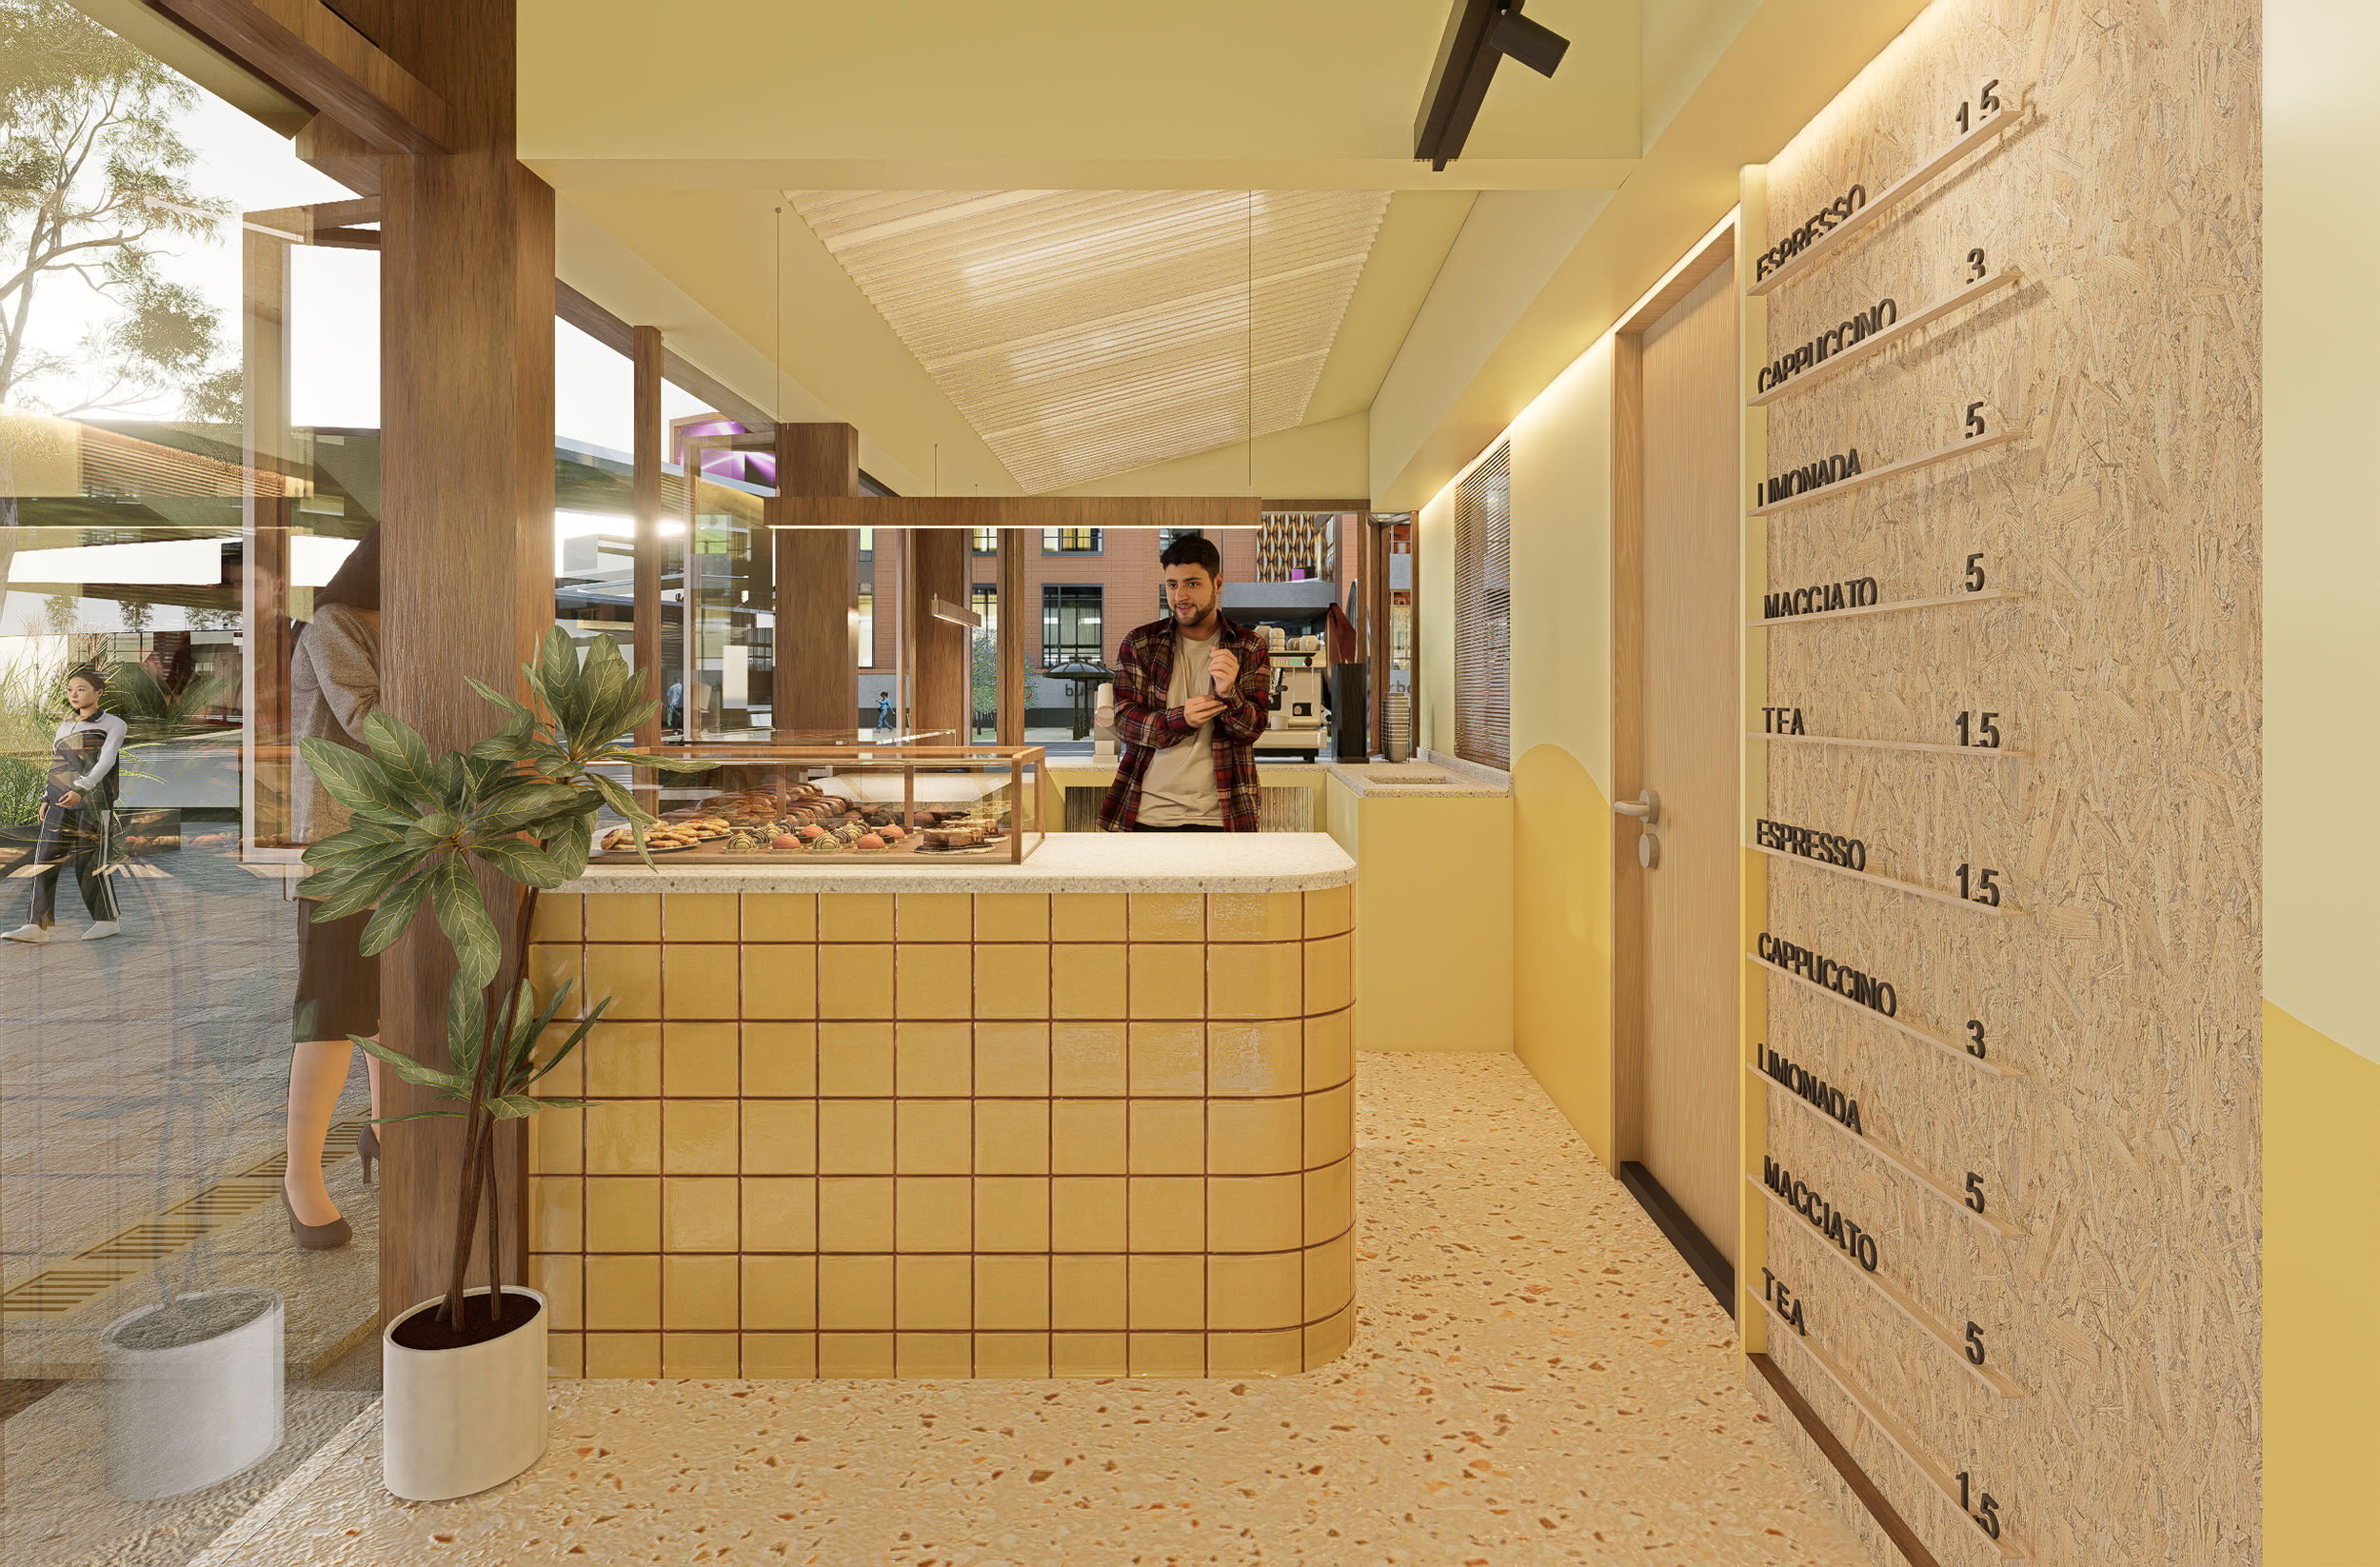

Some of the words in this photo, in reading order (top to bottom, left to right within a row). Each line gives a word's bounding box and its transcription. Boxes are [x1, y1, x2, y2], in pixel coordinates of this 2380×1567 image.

[1756, 184, 1866, 284] ESPRESSO
[1757, 298, 1896, 394] CAPPUCCINO
[1966, 248, 1986, 285] 3
[1757, 448, 1862, 507] LIMONADA
[1965, 402, 1985, 439] 5
[1764, 577, 1877, 620] MACCIATO
[1965, 553, 1985, 592] 5
[1761, 707, 1805, 735] TEA
[1756, 819, 1866, 871] ESPRESSO
[1757, 932, 1896, 1018] CAPPUCCINO
[1966, 1020, 1986, 1060] 3
[1757, 1043, 1862, 1136] LIMONADA
[1965, 1172, 1985, 1214] 5
[1761, 1267, 1806, 1337] TEA
[1764, 1155, 1877, 1272] MACCIATO
[1965, 1321, 1985, 1365] 5
